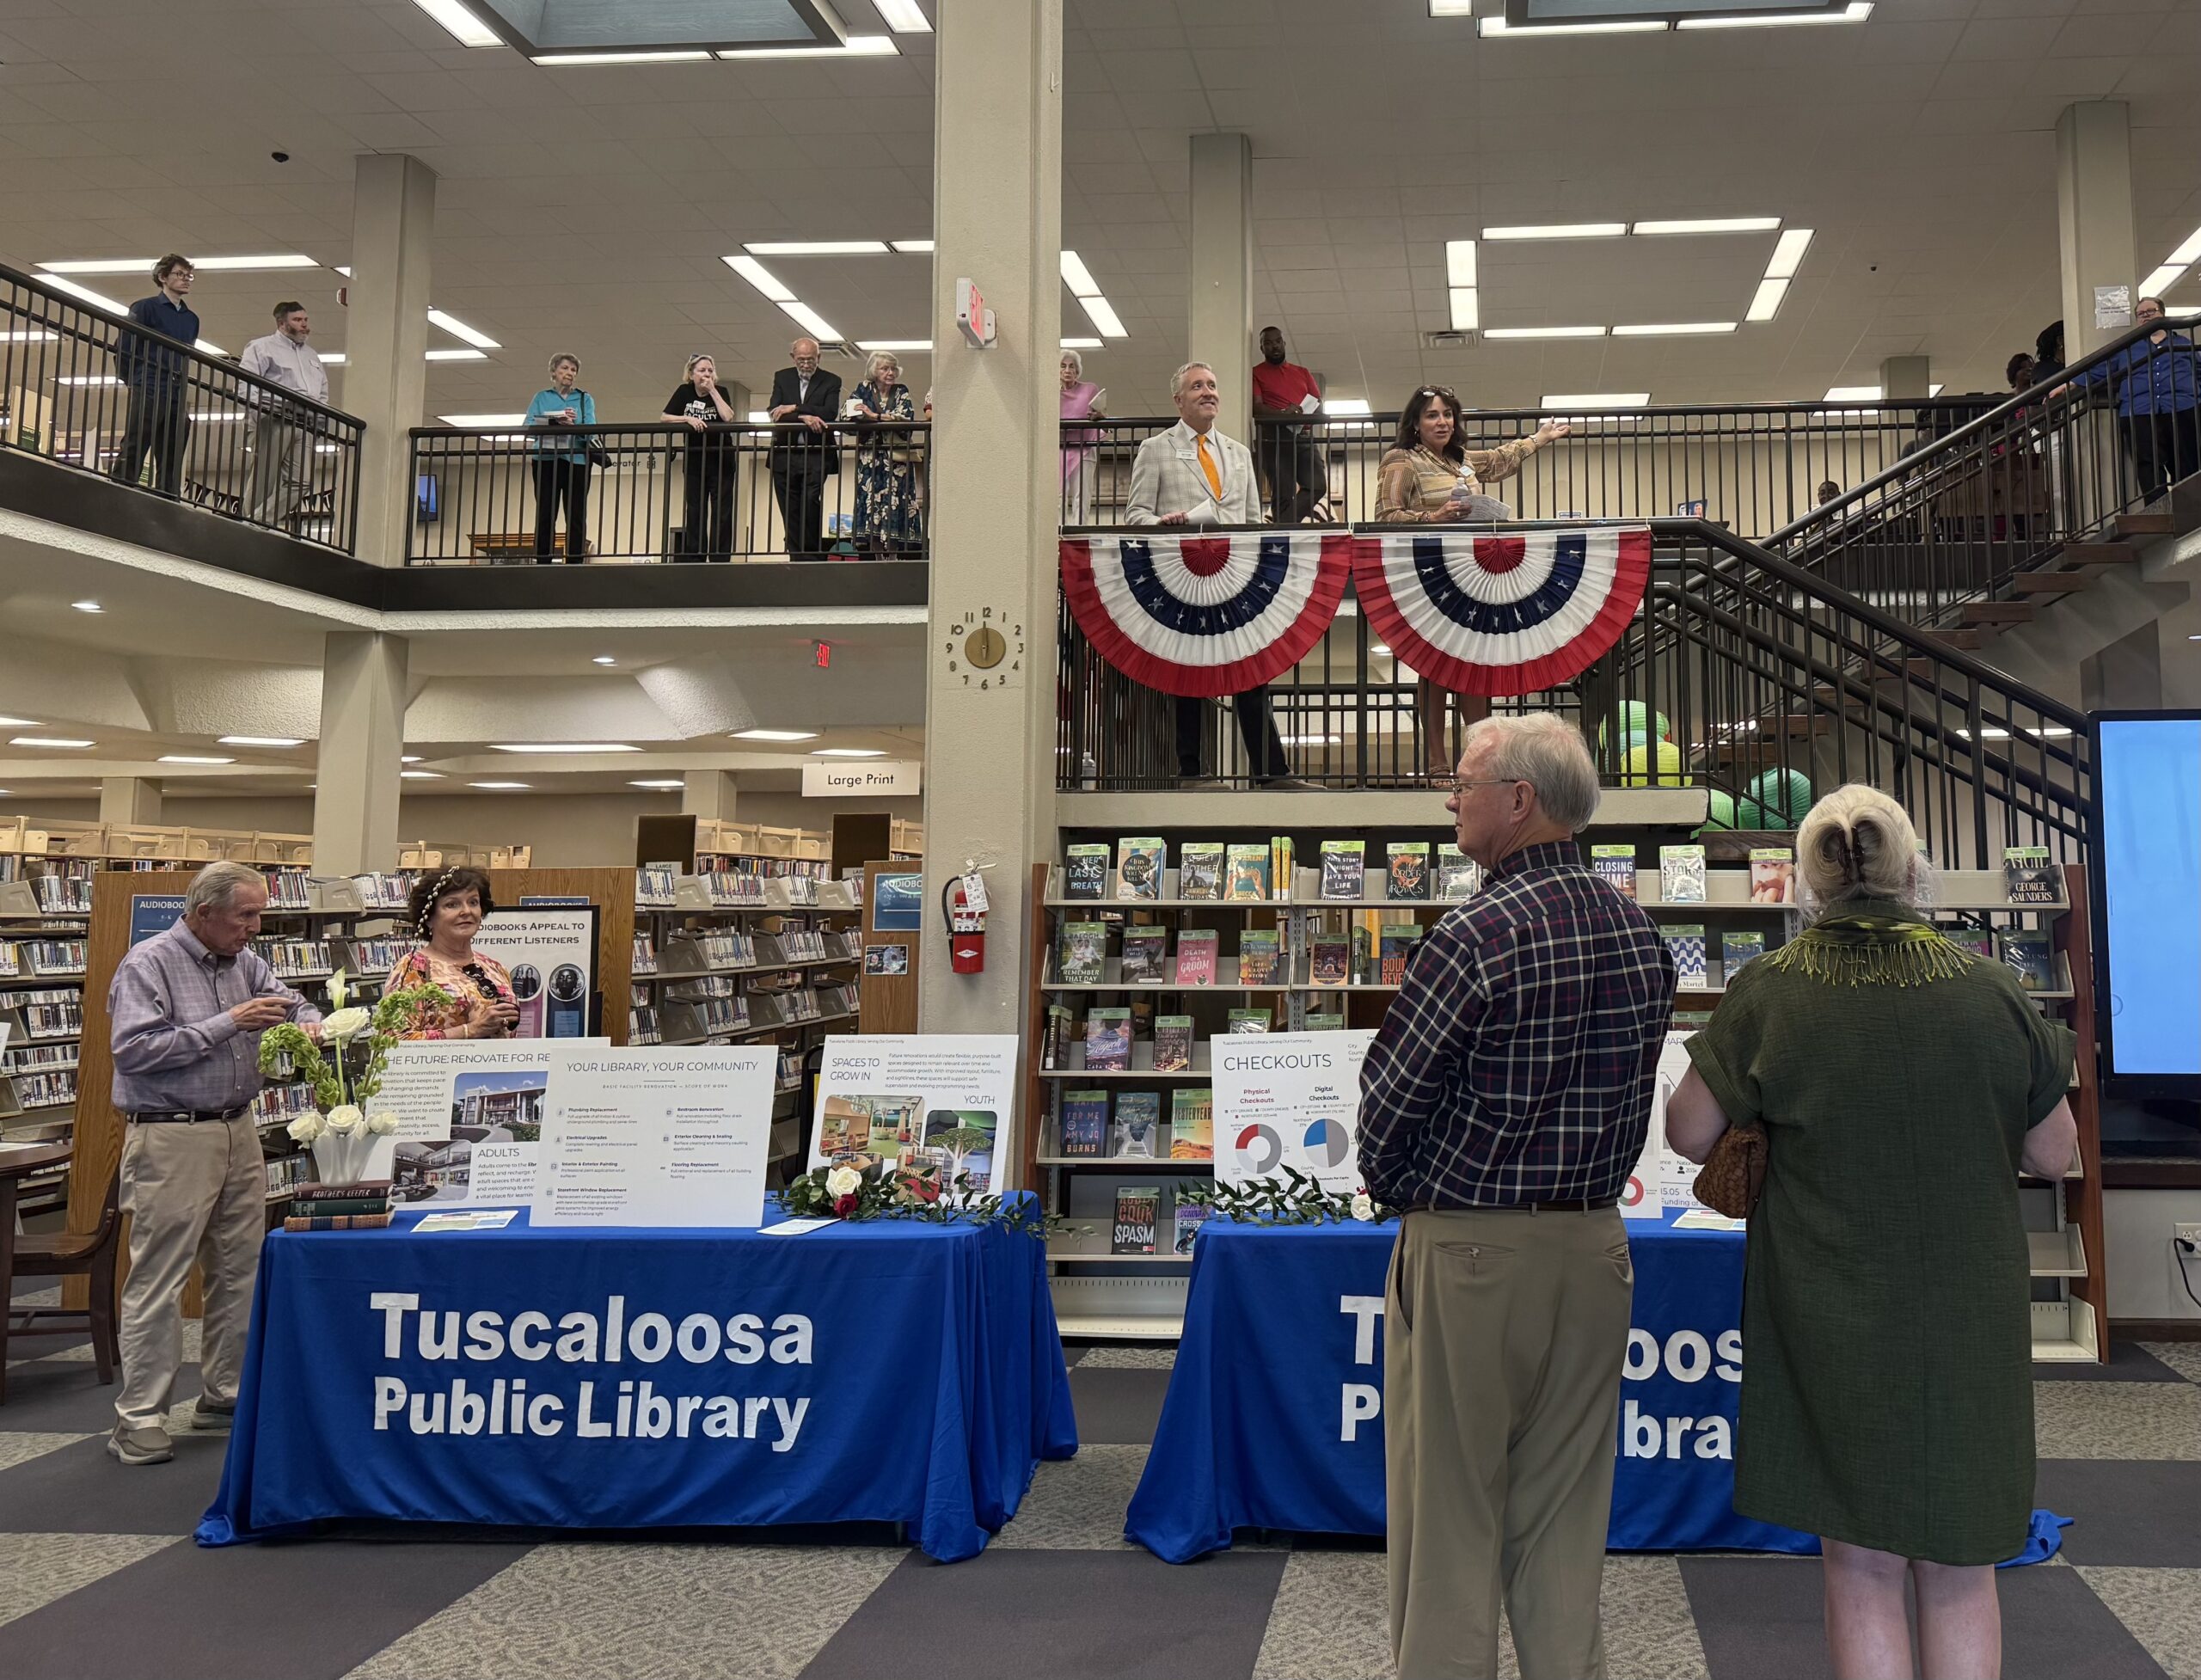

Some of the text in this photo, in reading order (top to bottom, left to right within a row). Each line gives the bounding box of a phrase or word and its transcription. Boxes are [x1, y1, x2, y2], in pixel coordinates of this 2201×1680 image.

[965, 612, 973, 622] 11
[983, 606, 991, 618] 12
[1002, 611, 1006, 622] 1
[951, 624, 964, 635] 10
[1015, 624, 1021, 635] 2
[946, 643, 953, 653] 9
[1018, 643, 1024, 653] 3
[949, 660, 956, 671] 8
[1012, 660, 1019, 671] 4
[963, 675, 969, 684] 7
[981, 678, 988, 690] 6
[999, 675, 1006, 685] 5
[828, 774, 894, 788] Large Print
[1595, 861, 1633, 873] CLOSING
[1071, 881, 1102, 890] BREATH
[2015, 882, 2046, 892] GEORGE
[2012, 892, 2052, 902] SAUNDERS
[1180, 960, 1210, 974] GROOM
[404, 1055, 450, 1064] FUTURE:
[451, 1054, 509, 1064] RENOVATE
[512, 1053, 532, 1063] FOR
[538, 1053, 550, 1062] RE
[832, 1058, 880, 1068] SPACES TO
[1223, 1054, 1332, 1071] CHECKOUTS
[567, 1061, 758, 1073] YOUR LIBRARY, YOUR COMMUNITY
[830, 1071, 871, 1081] GROW IN
[964, 1095, 996, 1105] YOUTH
[1067, 1112, 1099, 1120] FOR ME
[1174, 1107, 1211, 1121] YESTERYEAR
[1065, 1130, 1084, 1138] AMY
[478, 1148, 520, 1157] ADULTS
[1067, 1144, 1096, 1153] BURNS
[1119, 1205, 1154, 1223] COOK
[1114, 1225, 1155, 1244] SPASM
[371, 1292, 813, 1364] Tuscaloosa
[373, 1376, 811, 1453] Public Library
